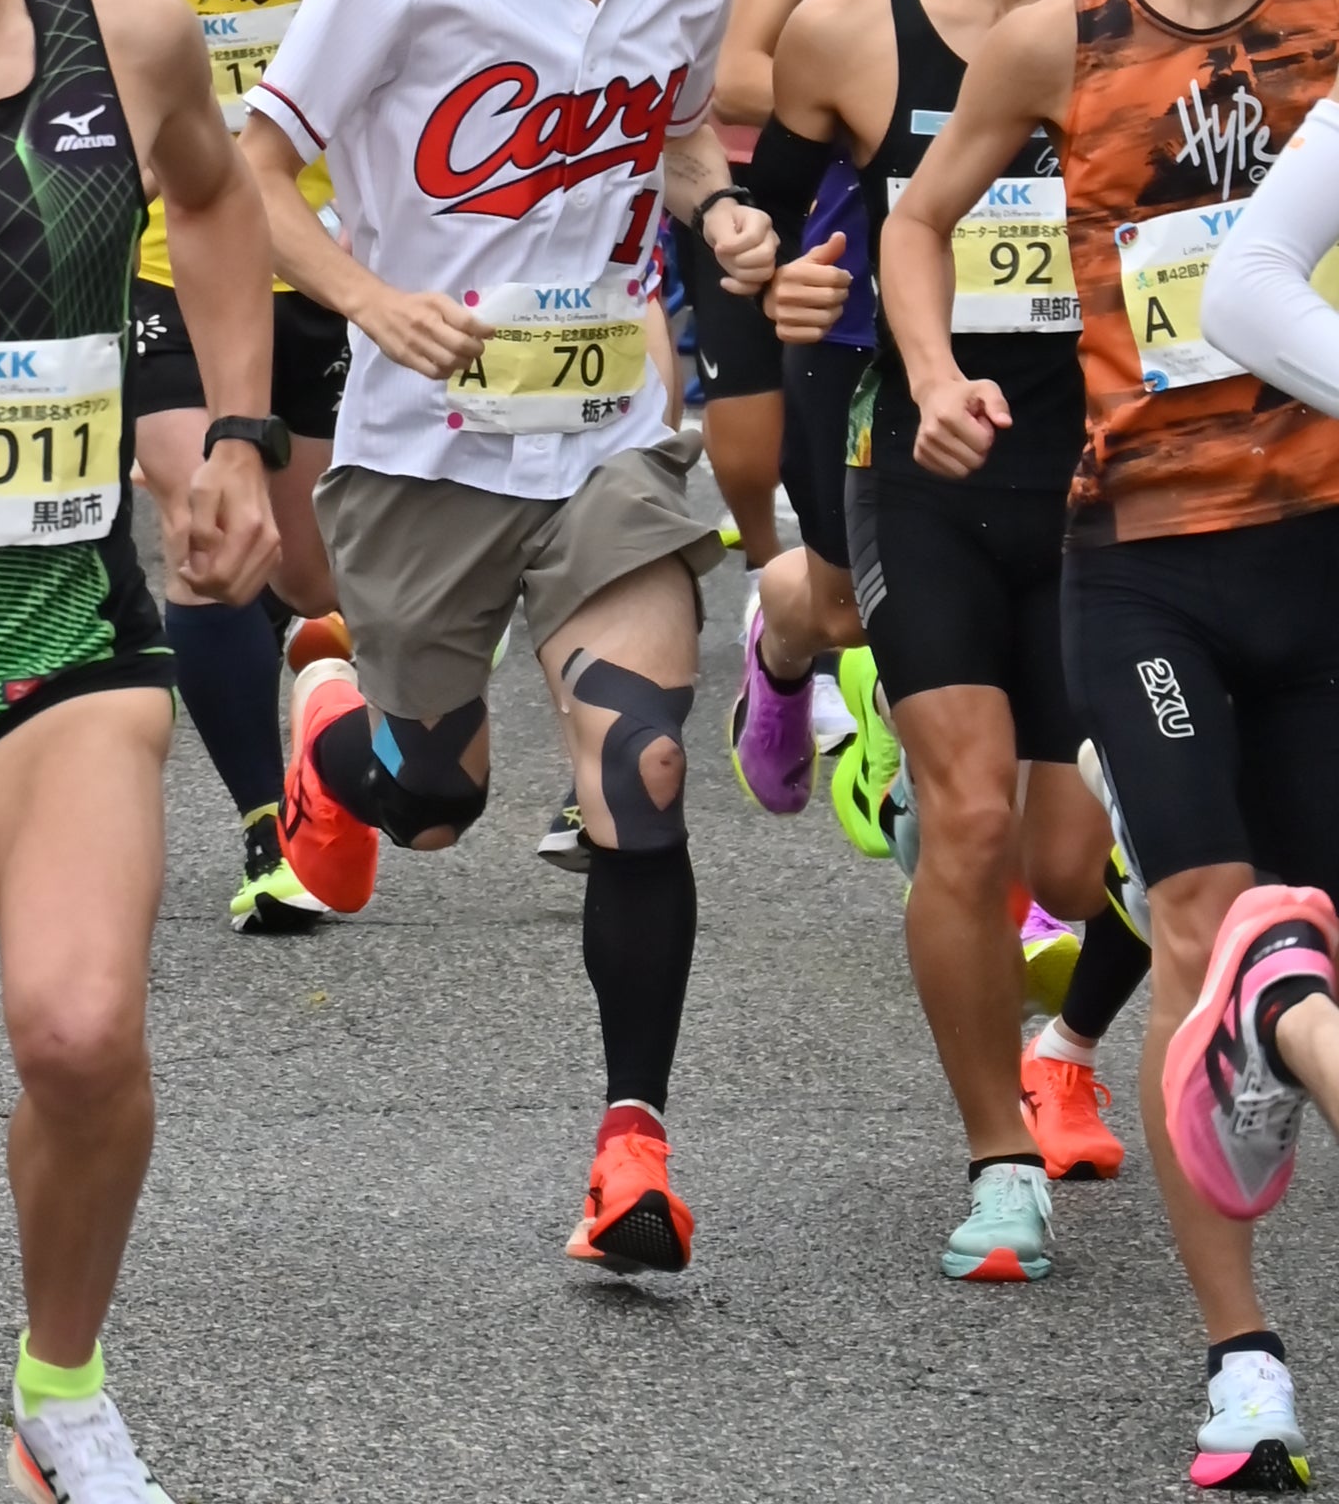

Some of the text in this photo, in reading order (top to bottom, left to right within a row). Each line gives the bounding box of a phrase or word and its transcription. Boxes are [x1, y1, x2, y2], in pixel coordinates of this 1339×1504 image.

[203, 17, 239, 36] KK
[987, 183, 1032, 206] KK
[609, 188, 660, 265] 1
[989, 242, 1053, 286] 92
[534, 287, 592, 310] YKK
[1145, 295, 1178, 343] A
[458, 343, 606, 389] A 70
[31, 493, 103, 533] 黒部市
[1136, 657, 1195, 738] 2XU
